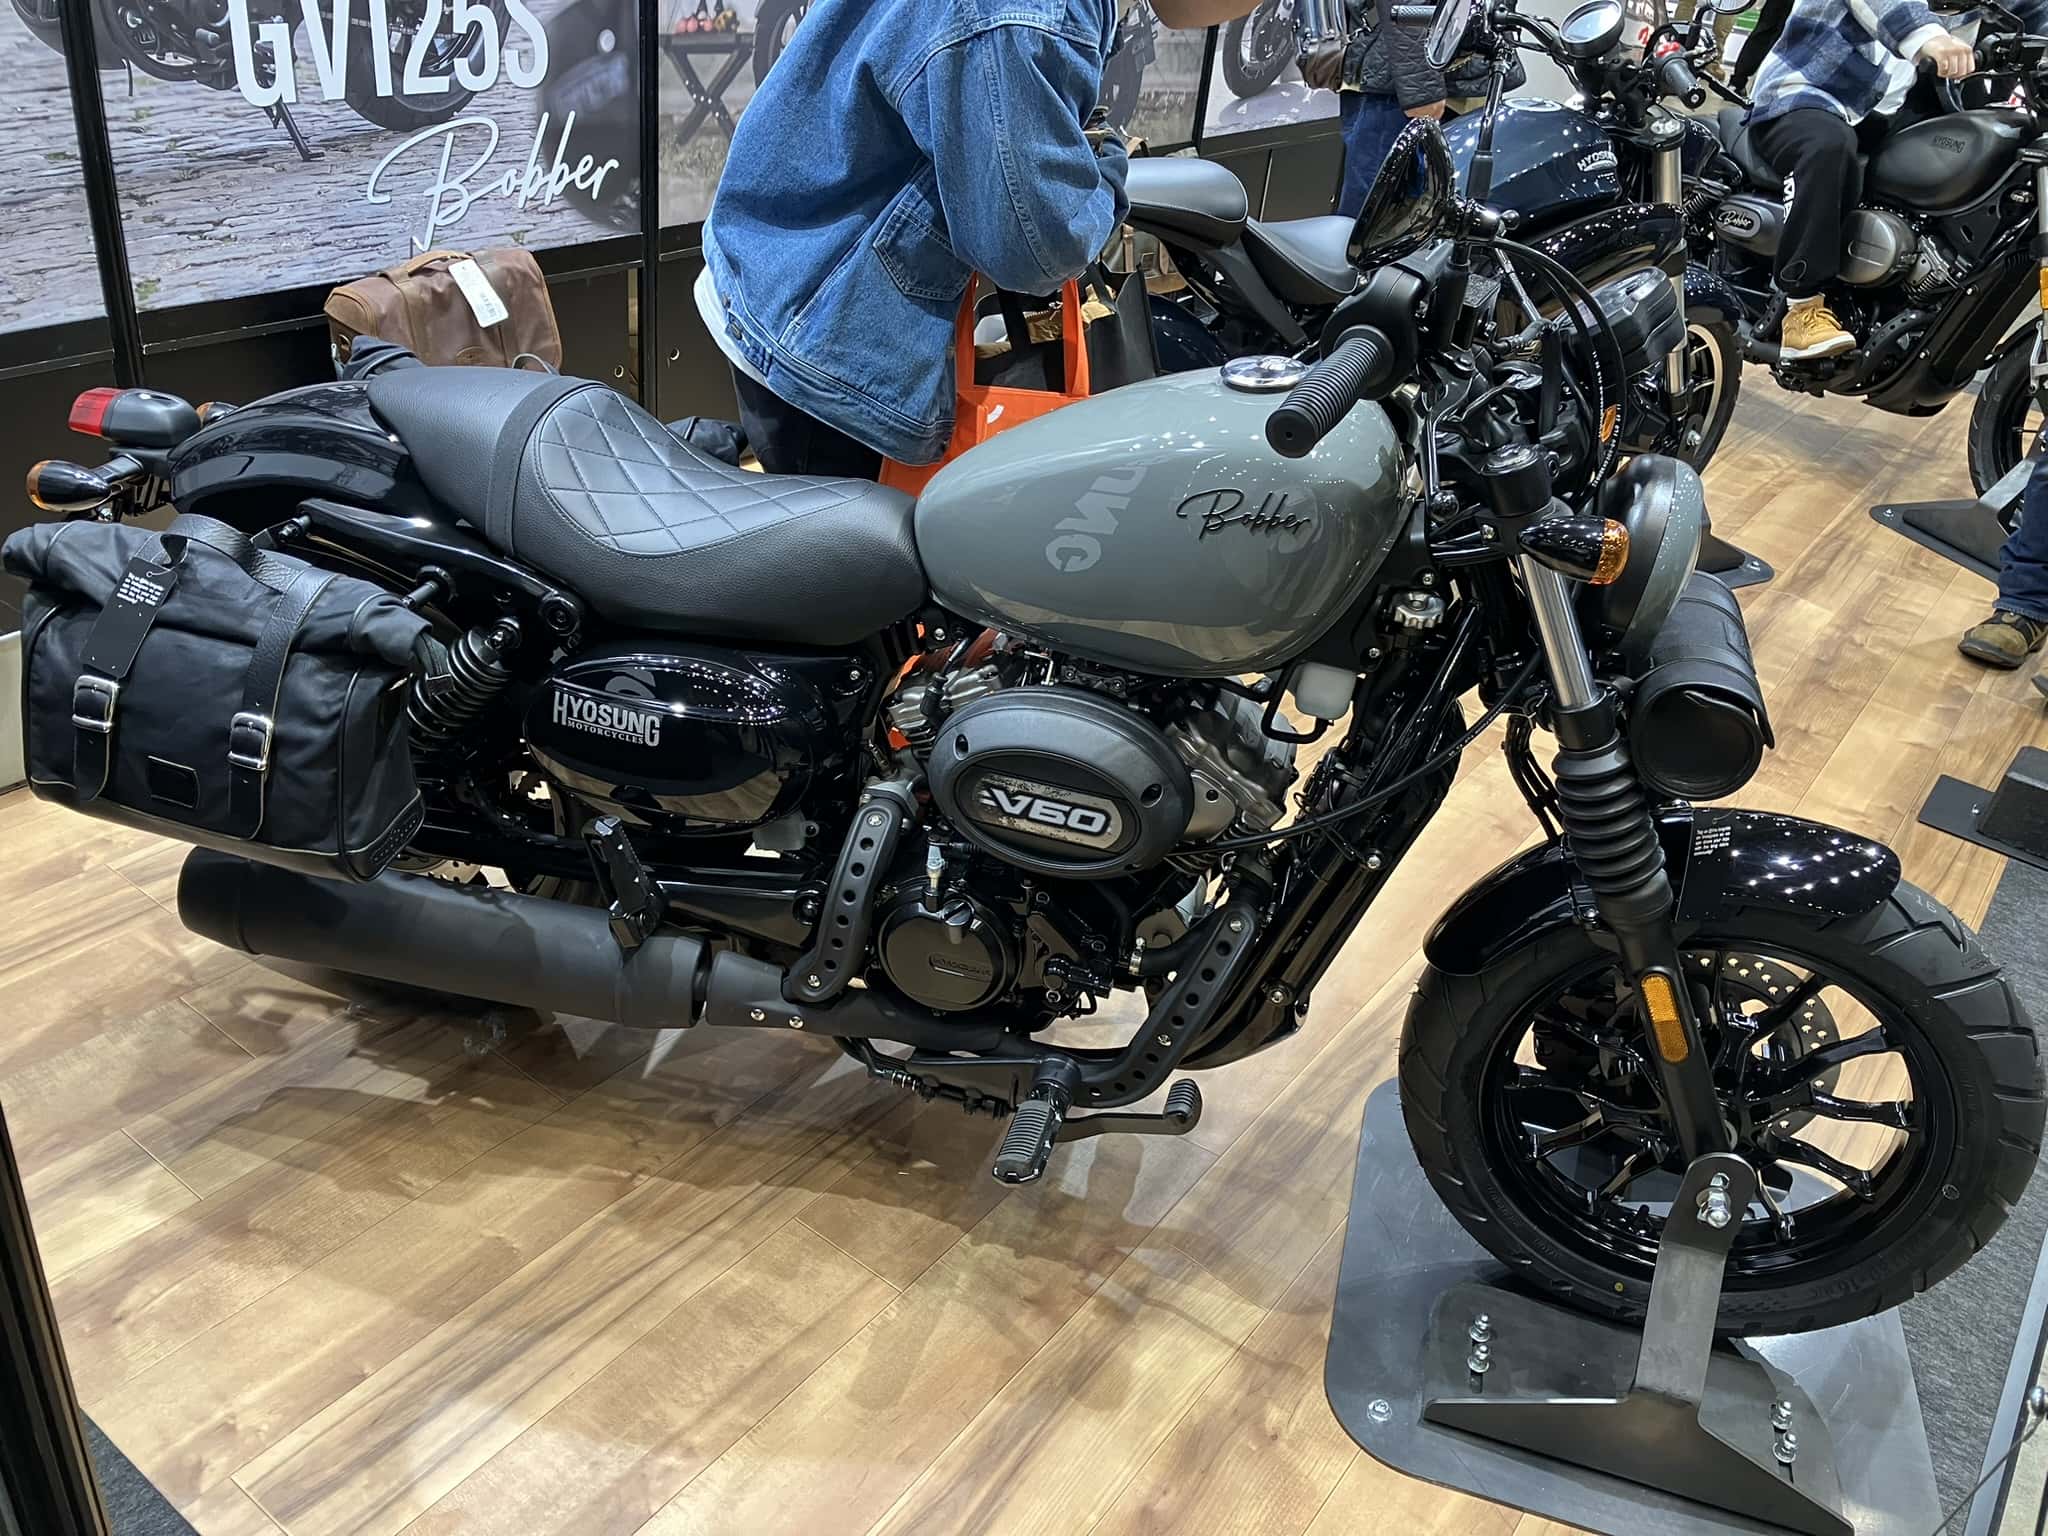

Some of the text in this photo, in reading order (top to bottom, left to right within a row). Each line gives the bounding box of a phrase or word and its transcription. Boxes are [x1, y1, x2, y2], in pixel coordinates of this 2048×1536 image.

[230, 0, 549, 108] GV125S
[367, 110, 620, 251] Bobber
[1176, 488, 1311, 541] Bobber
[553, 691, 660, 747] HYOSUNG
[567, 720, 644, 745] MOTORCYCLES
[989, 786, 1107, 834] V60
